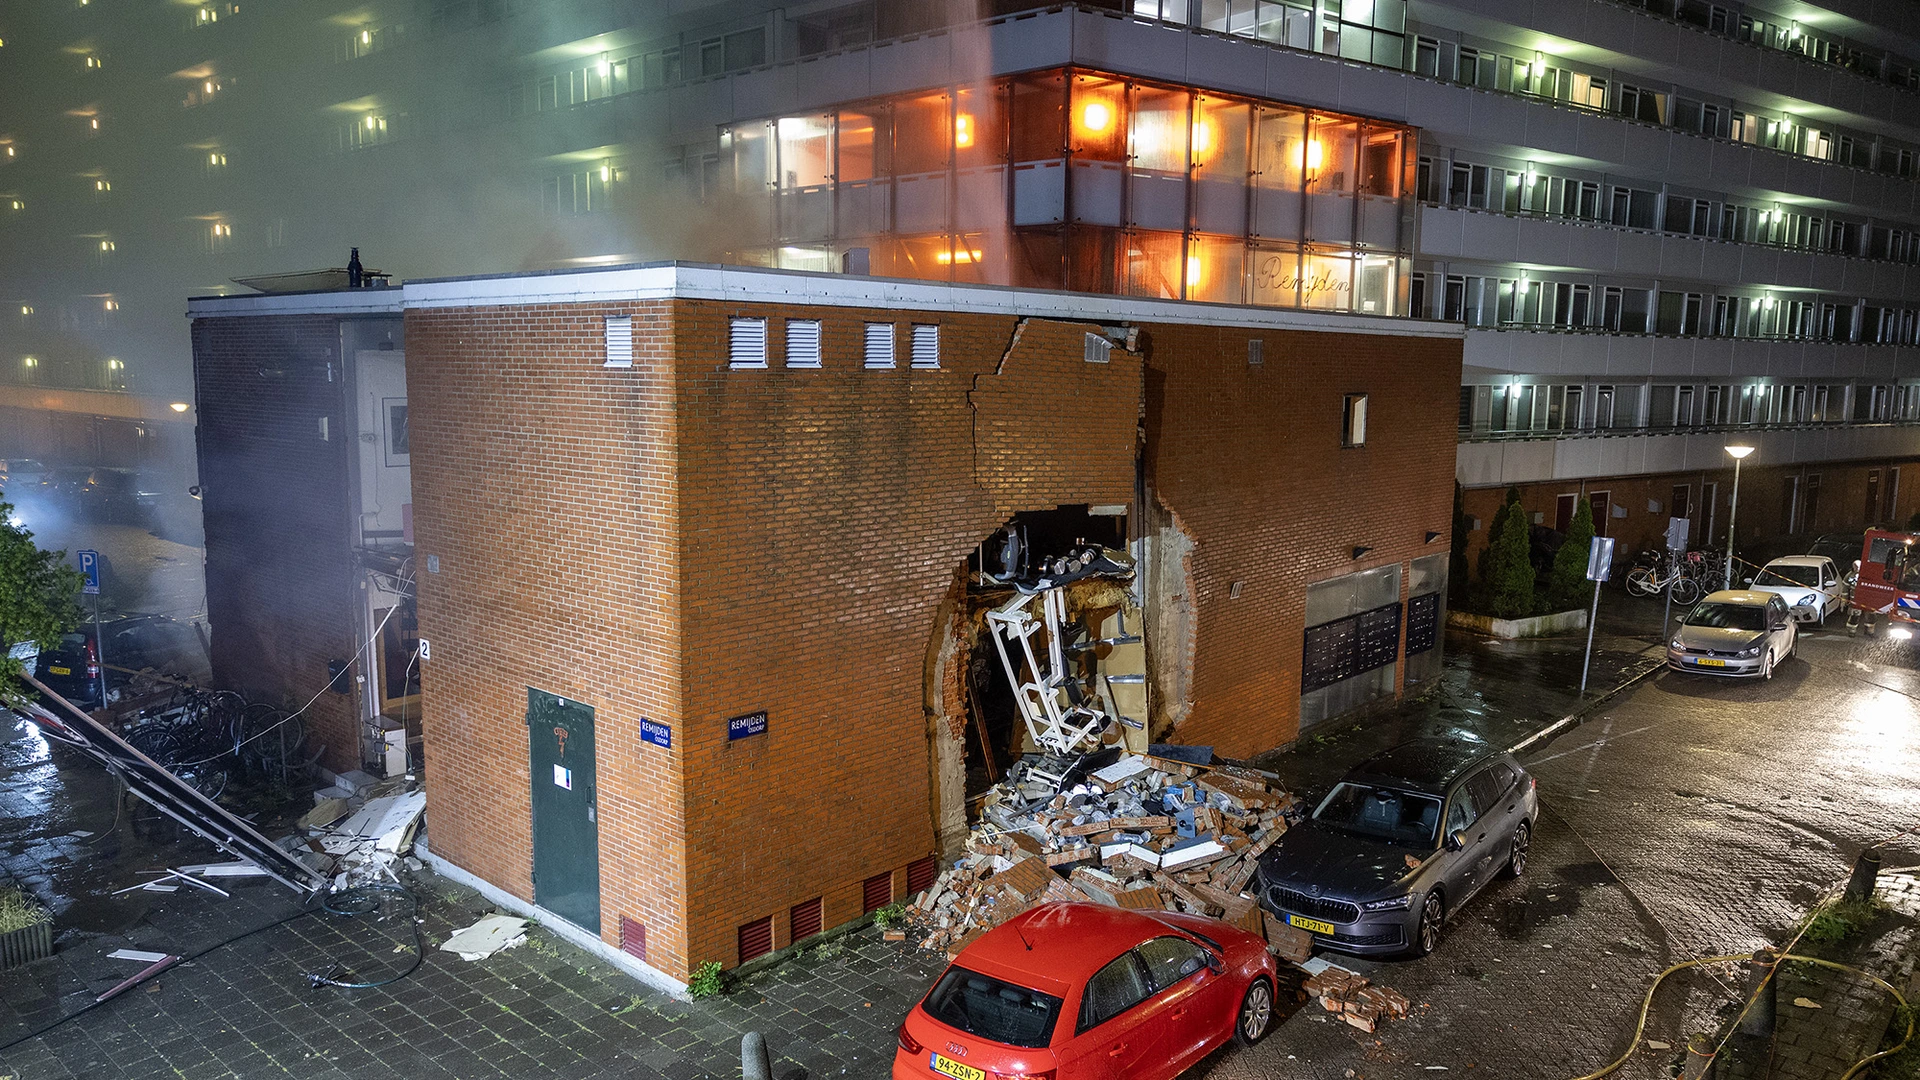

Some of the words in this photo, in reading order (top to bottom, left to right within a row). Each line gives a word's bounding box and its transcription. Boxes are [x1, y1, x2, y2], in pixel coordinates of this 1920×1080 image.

[82, 554, 93, 572] P
[1860, 582, 1895, 592] BRANDWEER
[421, 641, 428, 657] 2
[641, 721, 669, 738] REMIJDEN
[731, 714, 765, 730] REMIJDEN
[1294, 917, 1330, 933] HTJ-71-V
[938, 1056, 981, 1080] 94-ZSN-2
